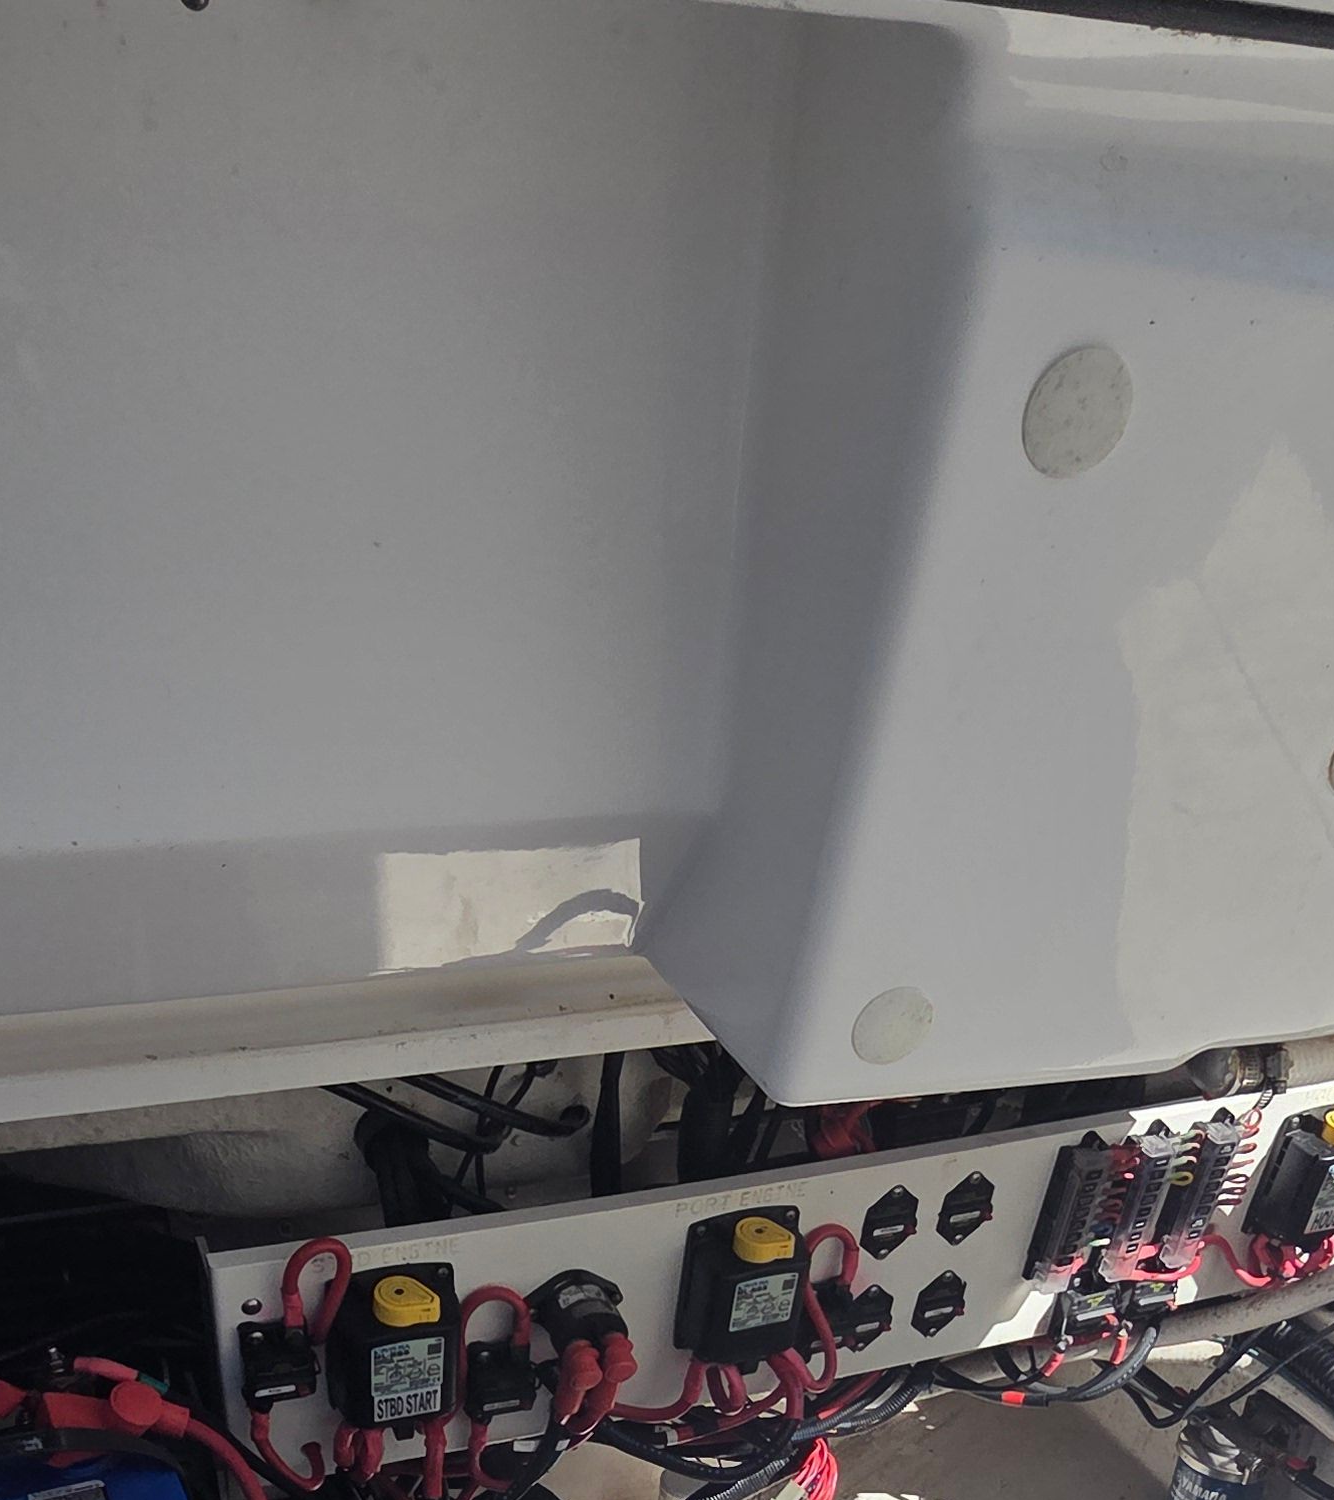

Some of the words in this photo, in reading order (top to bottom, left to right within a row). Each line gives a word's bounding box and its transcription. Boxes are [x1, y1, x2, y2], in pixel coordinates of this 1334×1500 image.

[675, 1195, 730, 1218] PORT
[740, 1181, 809, 1207] ENGINE
[382, 1237, 461, 1264] ENGINE
[377, 1396, 404, 1420] STBD
[405, 1390, 438, 1414] START
